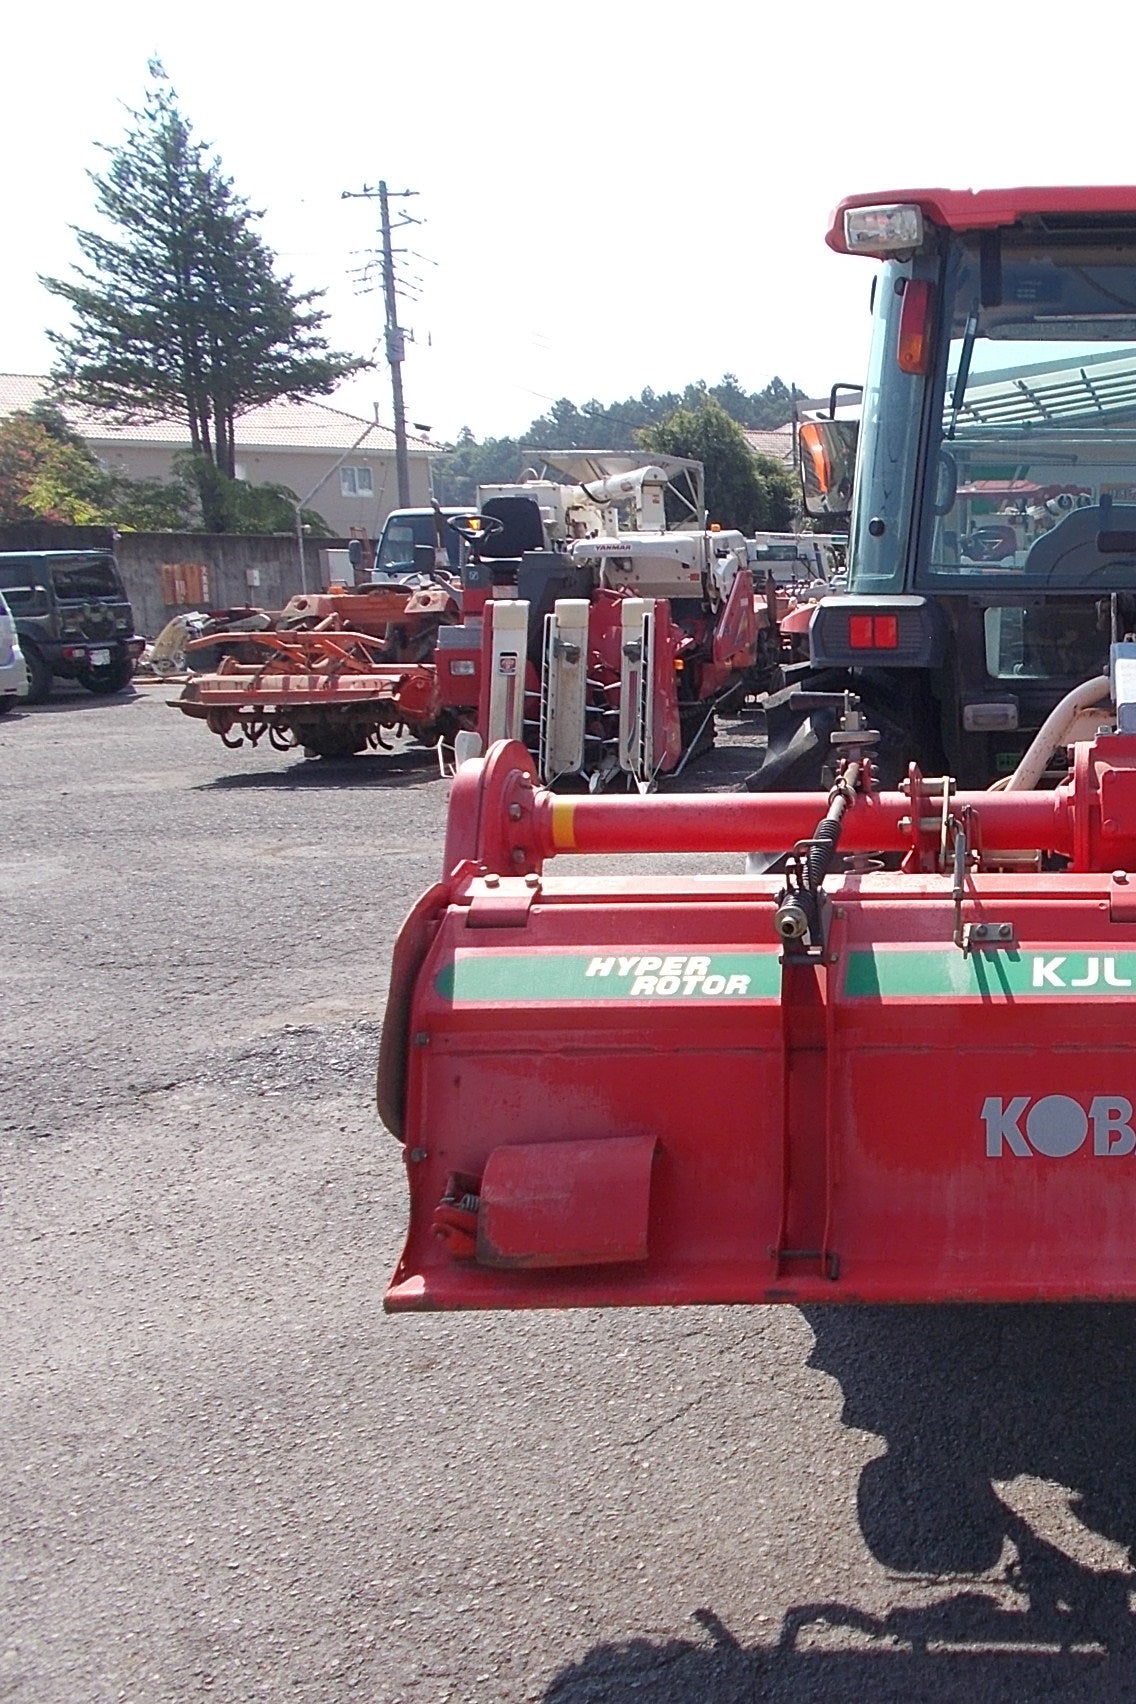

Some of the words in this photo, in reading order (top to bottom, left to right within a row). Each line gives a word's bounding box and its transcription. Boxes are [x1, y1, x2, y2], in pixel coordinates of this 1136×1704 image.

[595, 543, 632, 551] YANMAR
[585, 956, 711, 977] HYPER
[630, 975, 752, 996] ROTOR
